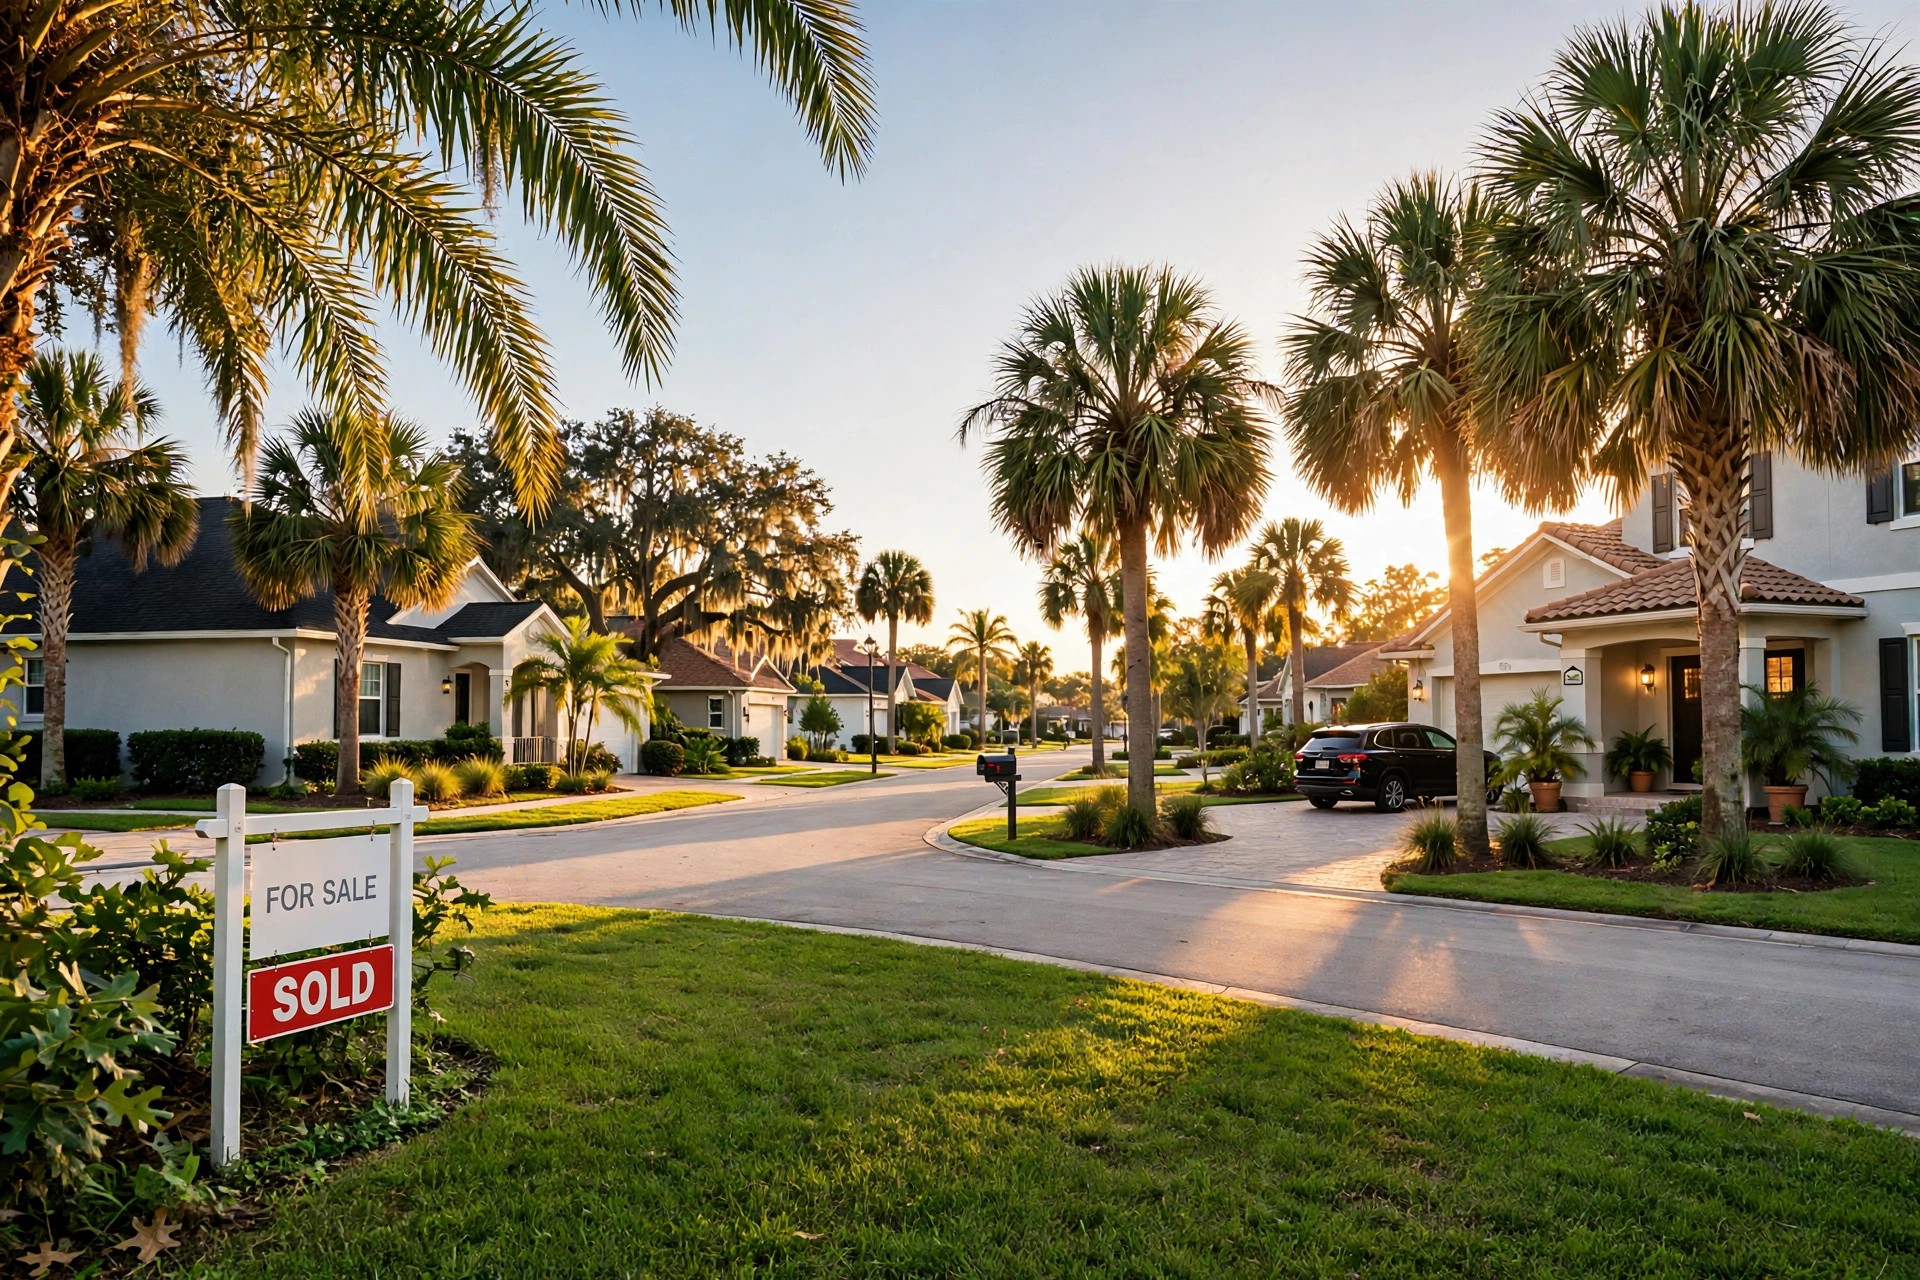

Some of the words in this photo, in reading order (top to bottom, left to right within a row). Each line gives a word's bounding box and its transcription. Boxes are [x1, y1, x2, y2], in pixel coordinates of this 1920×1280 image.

[266, 882, 315, 914] FOR
[322, 874, 377, 905] SALE
[271, 961, 375, 1023] SOLD
